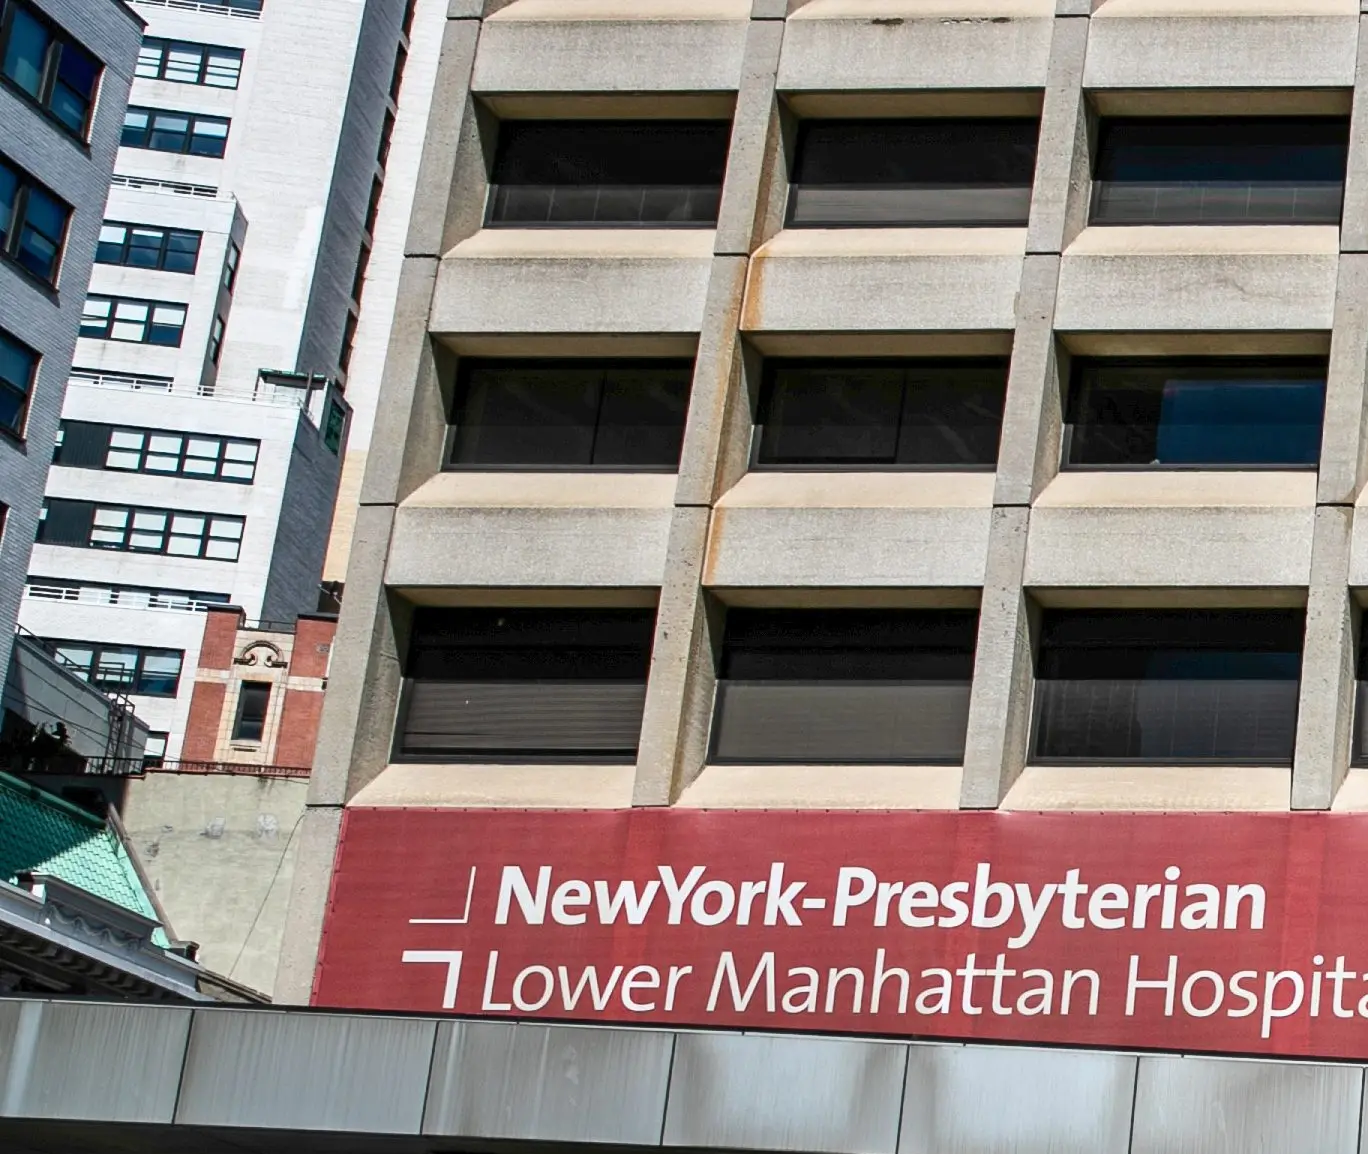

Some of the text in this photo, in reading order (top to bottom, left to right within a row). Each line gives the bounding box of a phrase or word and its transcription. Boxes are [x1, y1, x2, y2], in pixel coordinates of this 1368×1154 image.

[494, 862, 1266, 949] NewYork-Presbyterian
[480, 950, 692, 1012] Lower
[706, 948, 1100, 1016] Manhattan
